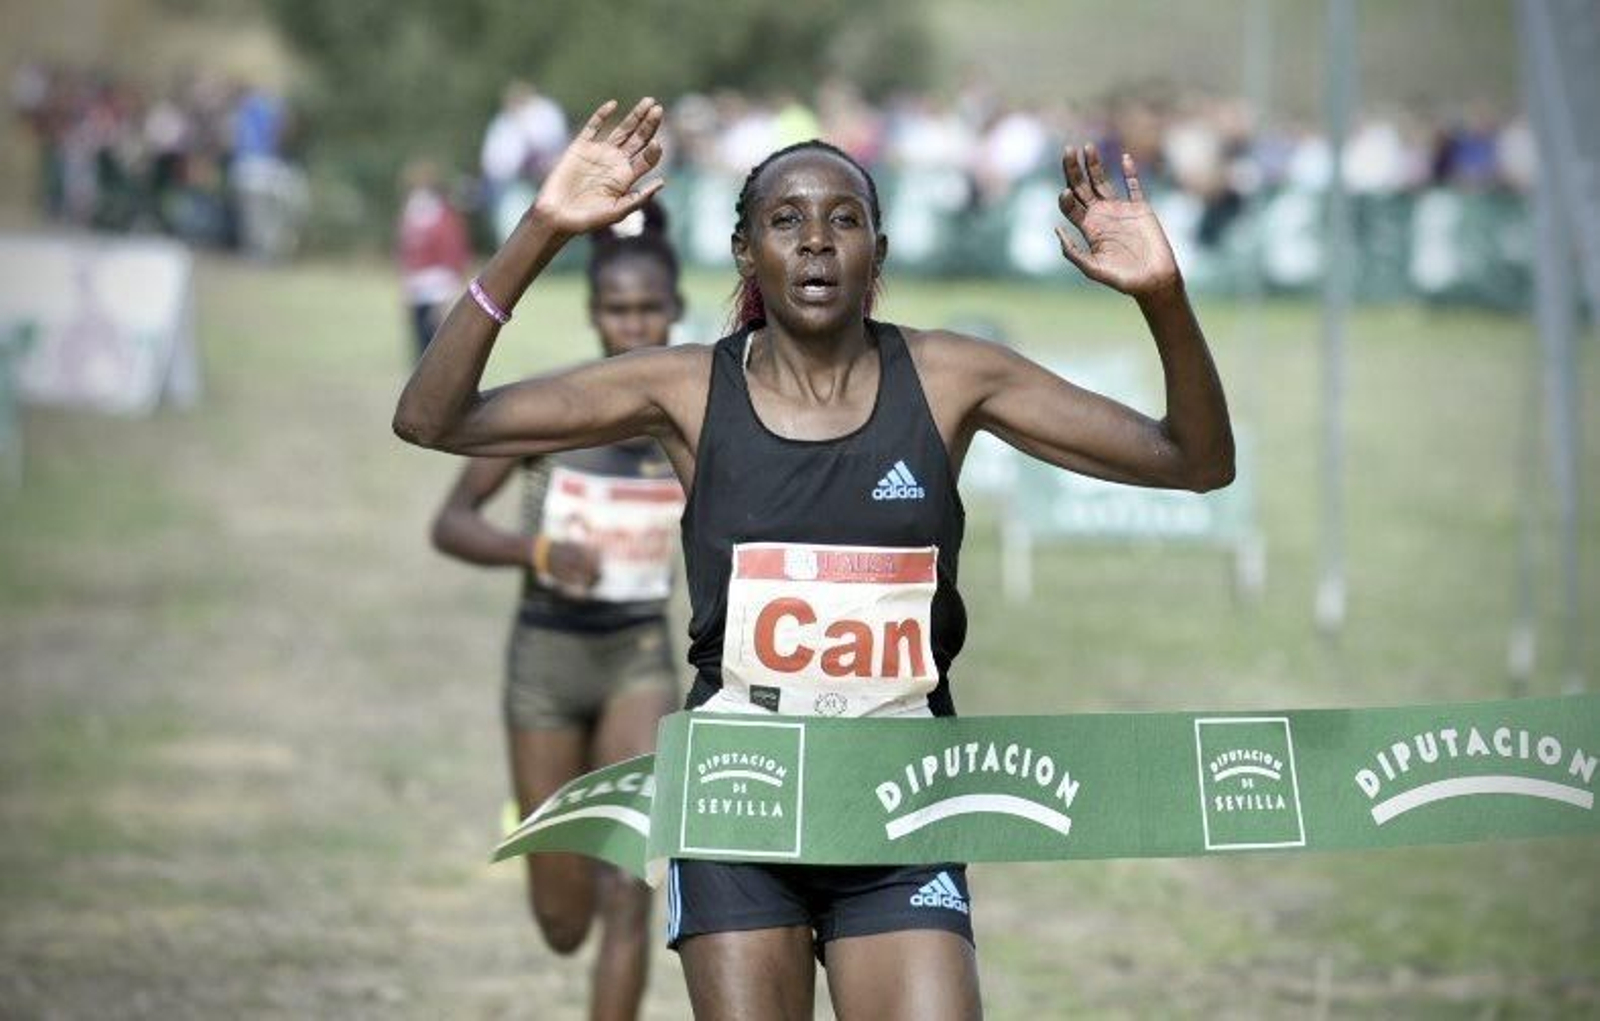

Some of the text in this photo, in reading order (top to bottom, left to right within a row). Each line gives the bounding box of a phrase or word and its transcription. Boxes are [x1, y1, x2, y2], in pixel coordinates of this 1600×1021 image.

[872, 485, 925, 500] adidas
[754, 597, 926, 678] Can
[698, 753, 787, 778] DIPUTACION
[1210, 749, 1283, 774] DIPUTACION
[1355, 727, 1598, 799] DIPUTACION
[733, 782, 747, 794] DE
[875, 741, 1080, 813] DIPUTACION
[698, 798, 783, 817] SEVILLA
[1214, 793, 1286, 812] SEVILLA
[910, 891, 968, 915] adidas
